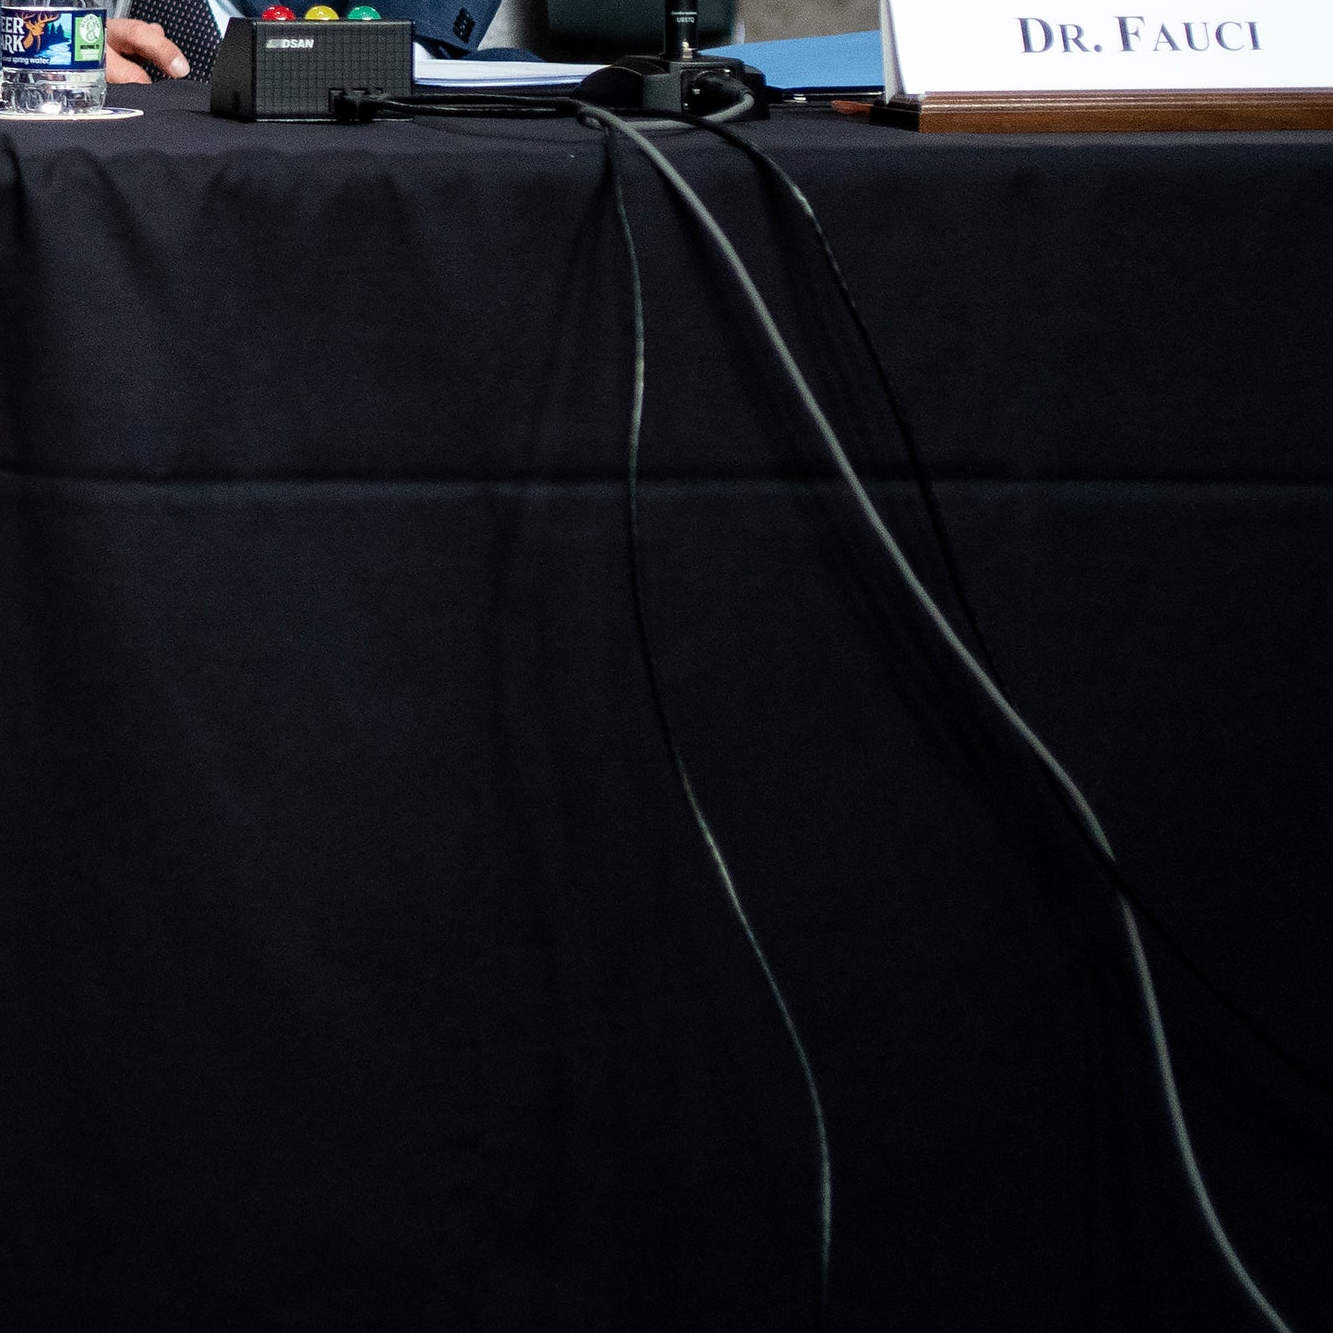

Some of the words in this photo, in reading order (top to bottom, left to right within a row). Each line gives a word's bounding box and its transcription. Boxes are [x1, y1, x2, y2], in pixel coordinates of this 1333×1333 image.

[1114, 15, 1264, 52] FAUCI
[281, 38, 315, 49] DSAN
[12, 56, 29, 65] spring
